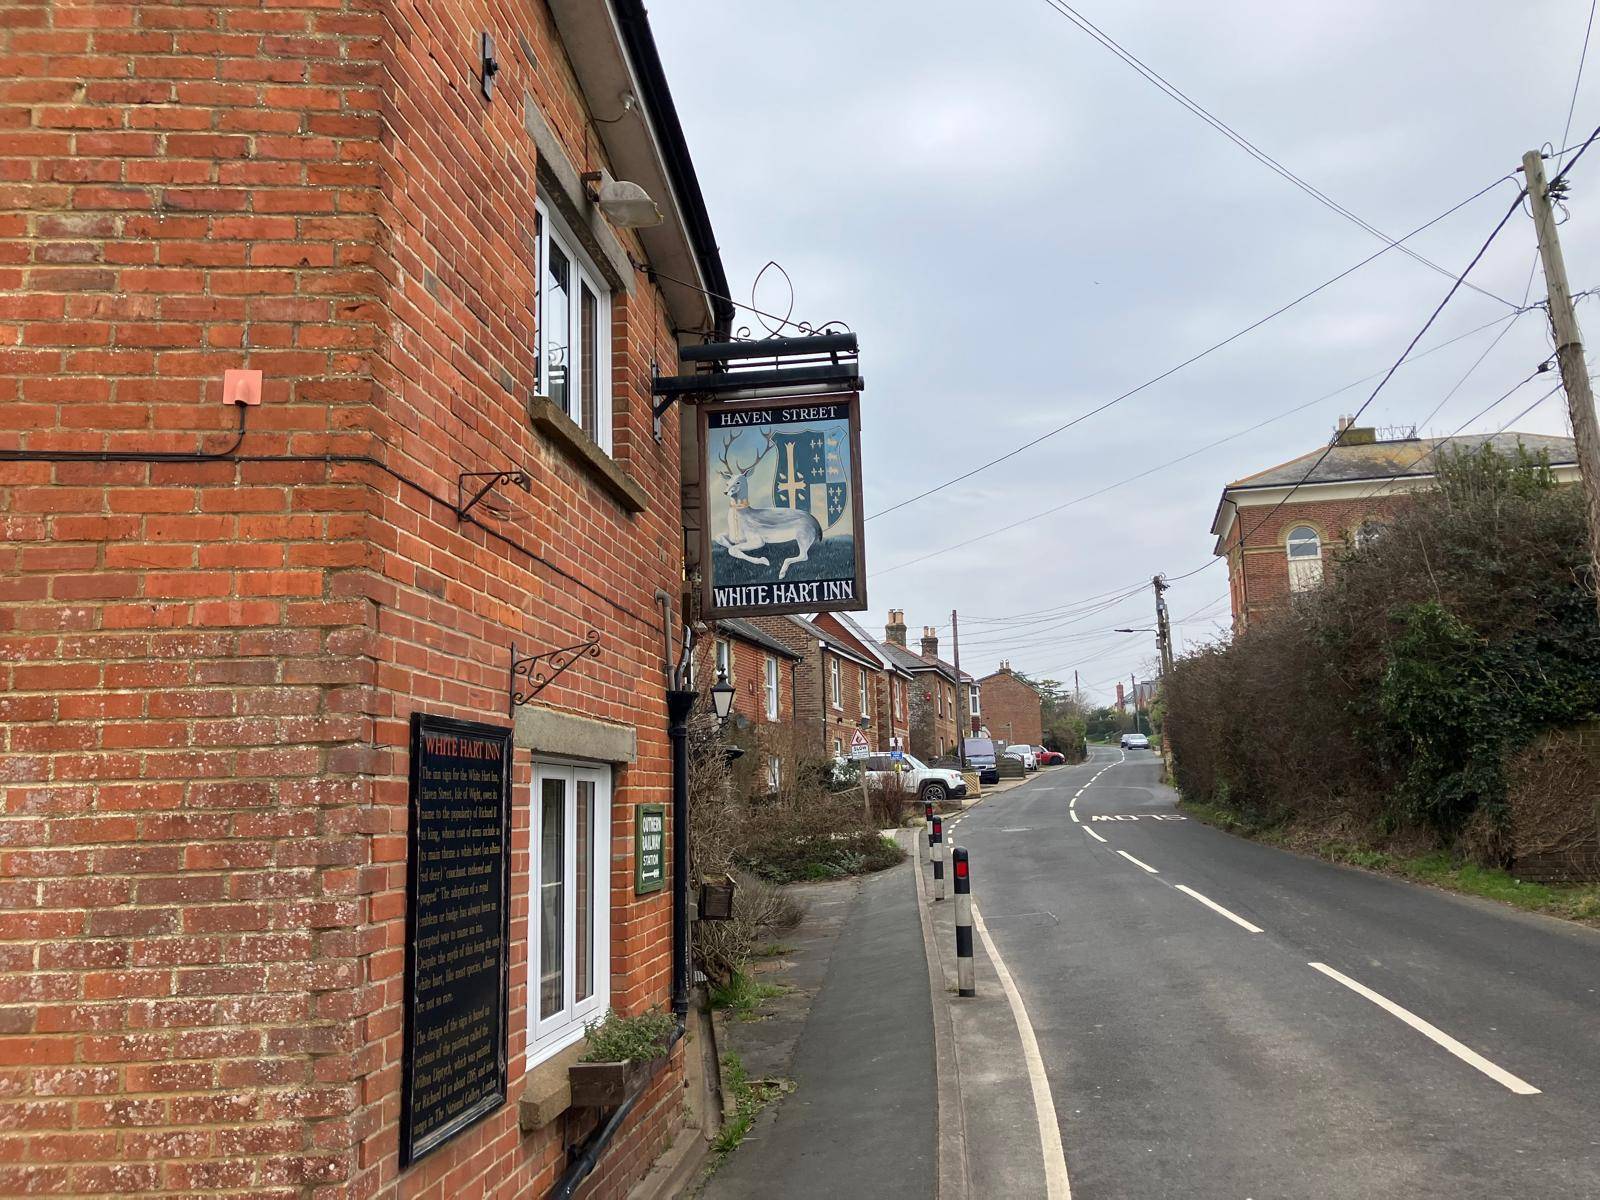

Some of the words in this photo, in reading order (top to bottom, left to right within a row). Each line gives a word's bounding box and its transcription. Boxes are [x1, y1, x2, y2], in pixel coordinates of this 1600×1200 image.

[721, 410, 772, 426] HAVEN
[782, 406, 837, 421] STREET
[714, 585, 770, 608] WHITE
[773, 582, 819, 604] HART
[824, 580, 853, 600] INN
[426, 736, 457, 756] WHITE
[460, 738, 482, 758] HART
[486, 742, 500, 760] INN
[422, 766, 432, 779] The
[468, 769, 480, 781] White
[482, 770, 490, 781] Hart
[463, 787, 468, 799] of
[643, 854, 658, 866] STATION
